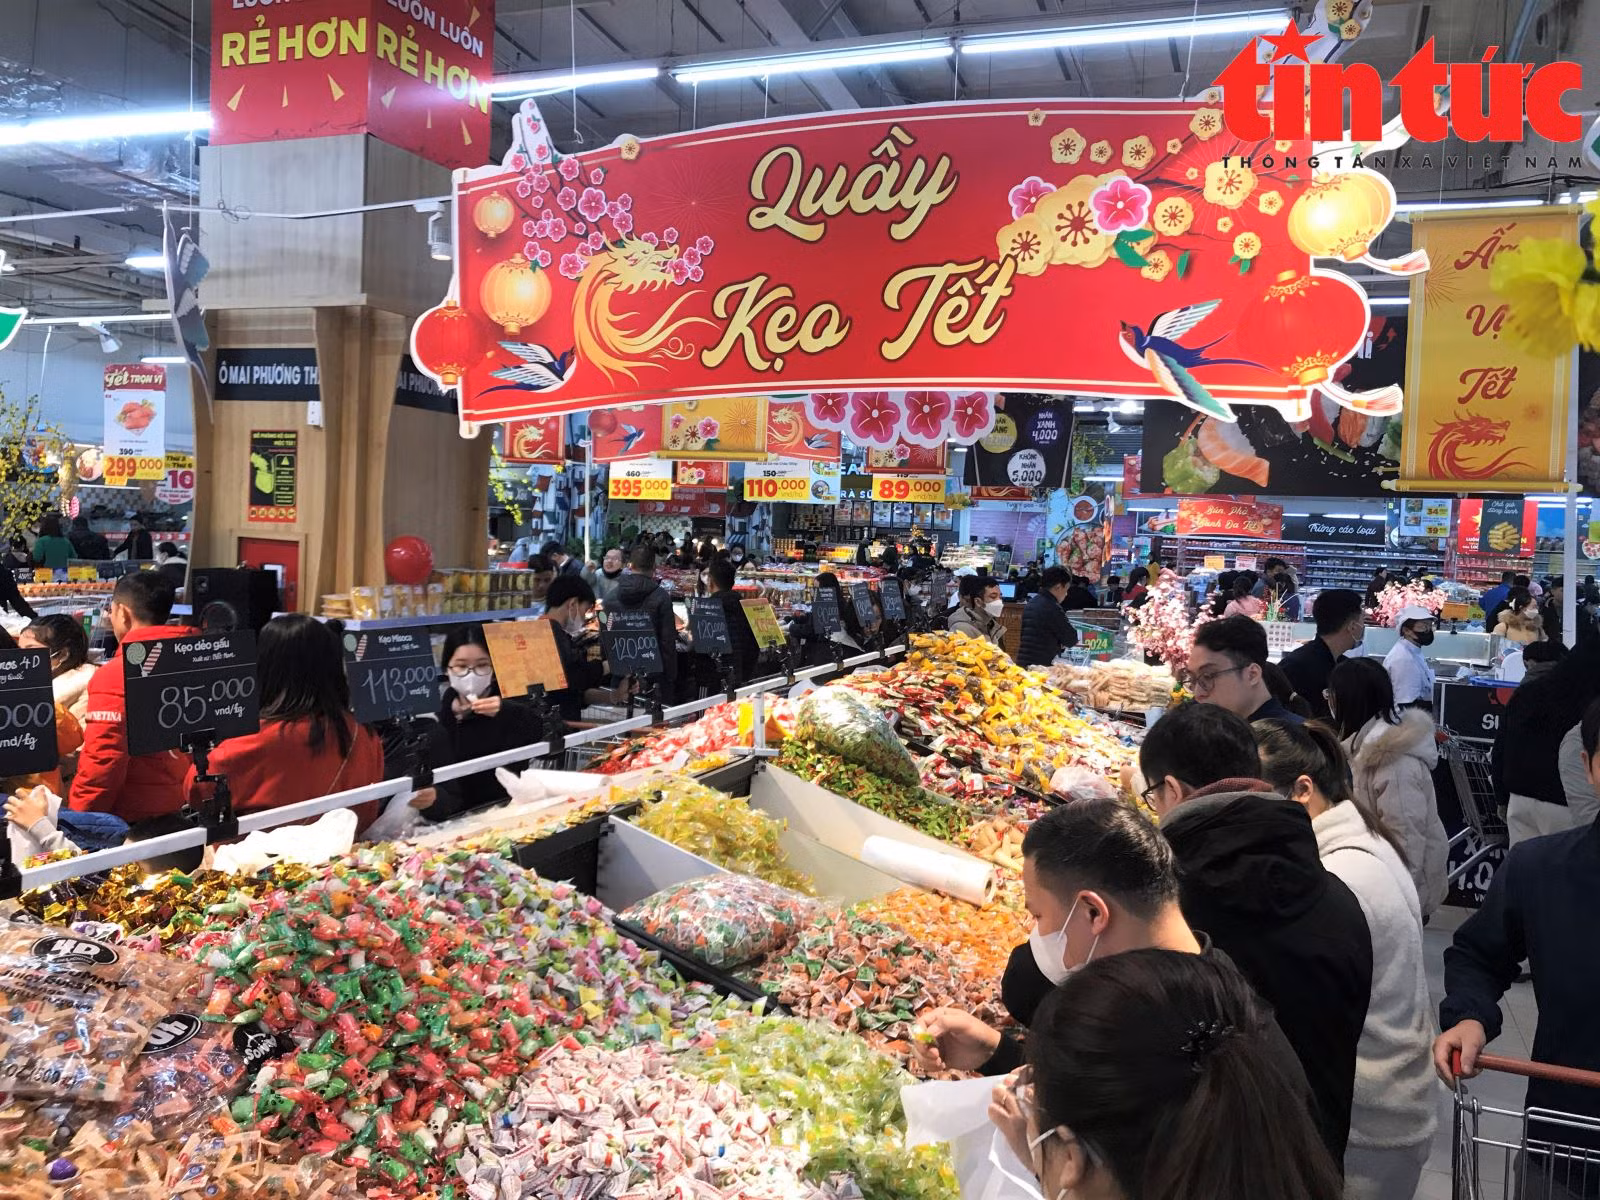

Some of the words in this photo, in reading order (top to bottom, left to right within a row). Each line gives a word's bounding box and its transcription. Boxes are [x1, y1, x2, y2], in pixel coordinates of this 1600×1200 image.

[221, 15, 271, 67] RẺ
[278, 17, 367, 61] HƠN
[440, 16, 484, 58] LUÔN
[376, 22, 420, 78] RẺ
[424, 49, 489, 115] HƠN
[747, 124, 960, 244] Quầy
[700, 272, 852, 373] Kẹo
[880, 253, 1018, 361] Tết
[253, 363, 301, 385] PHƯƠNG
[304, 366, 320, 385] TH
[1457, 366, 1518, 405] Tết
[1032, 429, 1059, 442] 4.000
[611, 480, 668, 497] 395.000
[746, 479, 806, 497] 110.000
[879, 480, 941, 499] 89.000
[1308, 522, 1336, 536] Trứng
[1338, 524, 1355, 535] các
[174, 642, 193, 654] Kẹo
[194, 639, 212, 651] dẻo
[213, 637, 230, 651] gấu
[611, 636, 657, 661] 120.000
[361, 666, 436, 704] 113.000
[158, 676, 256, 729] 85.000
[214, 702, 246, 718] vnd/kg
